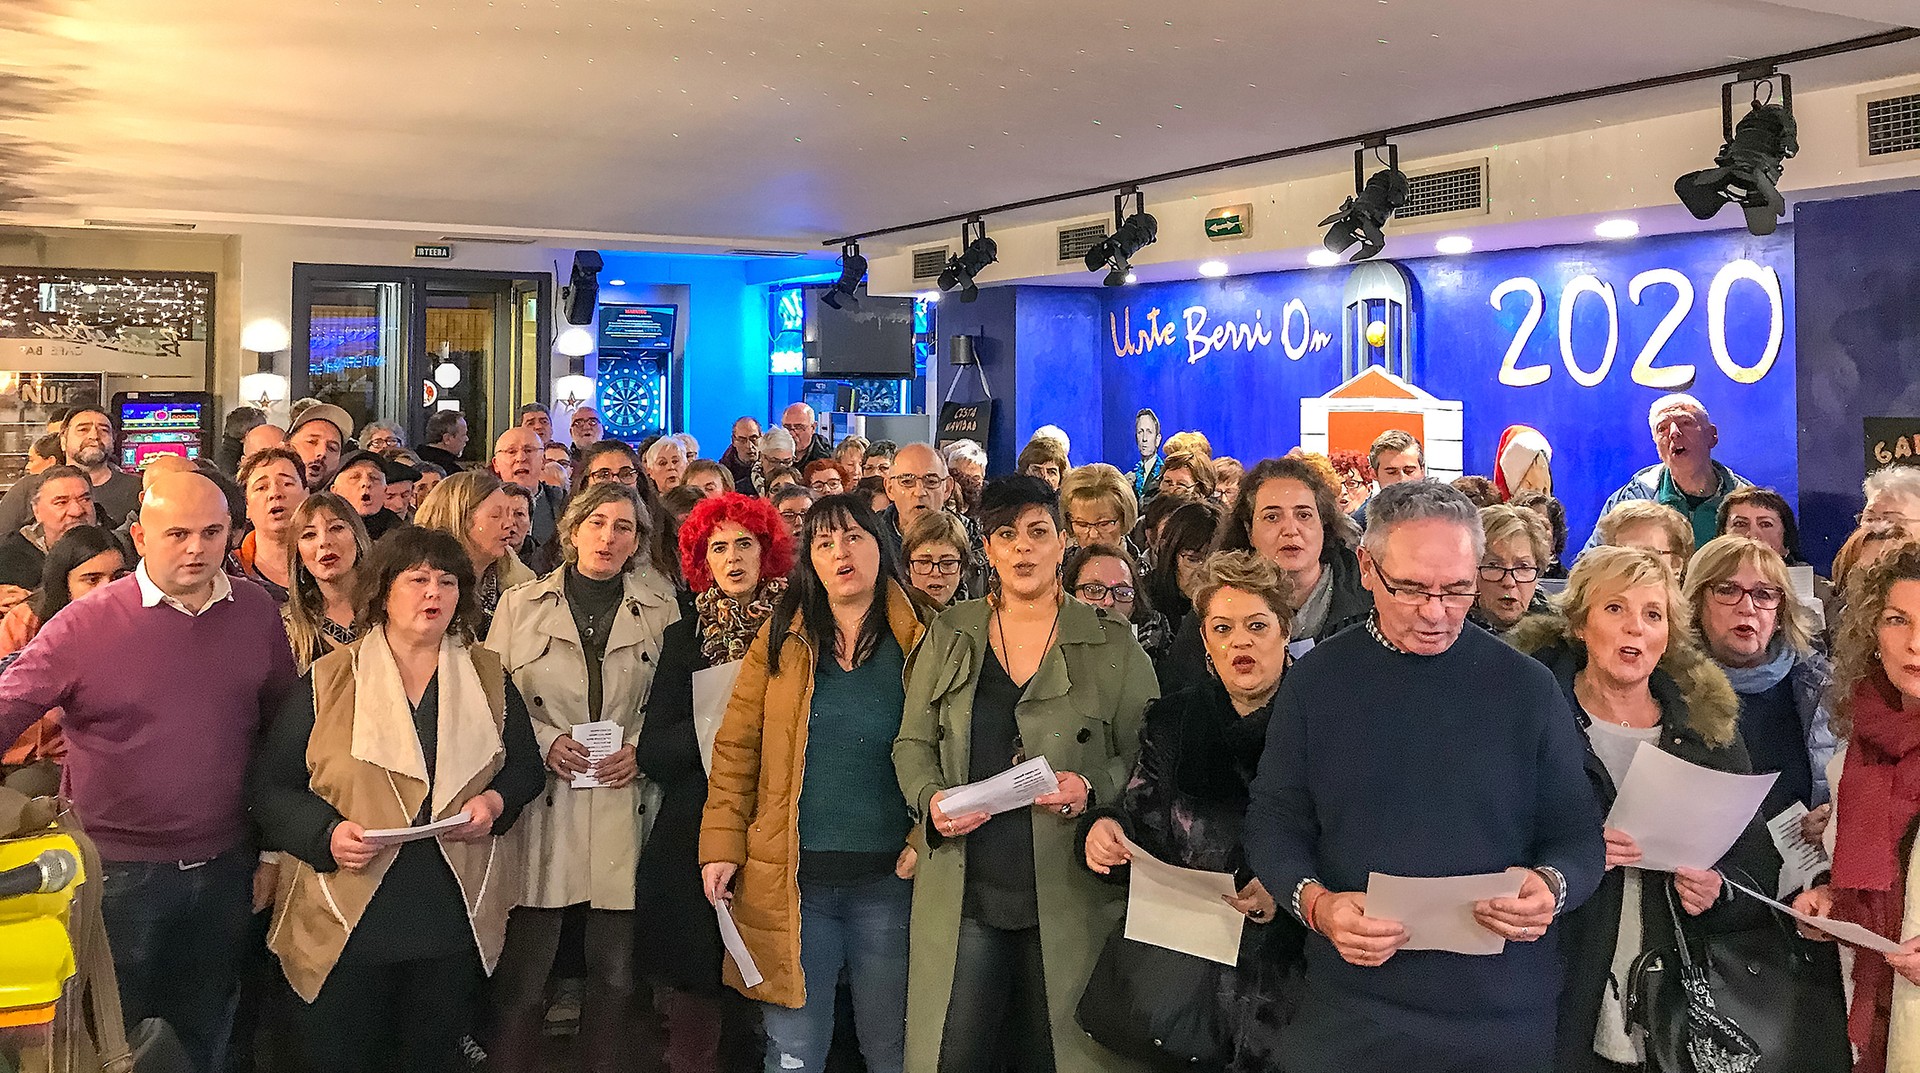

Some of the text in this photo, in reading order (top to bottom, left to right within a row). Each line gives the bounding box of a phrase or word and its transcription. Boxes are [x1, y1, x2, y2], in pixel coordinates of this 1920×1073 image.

[416, 247, 447, 256] IRTEERA
[1183, 305, 1272, 364] Berri
[1281, 298, 1332, 361] On
[1489, 258, 1785, 390] 2020
